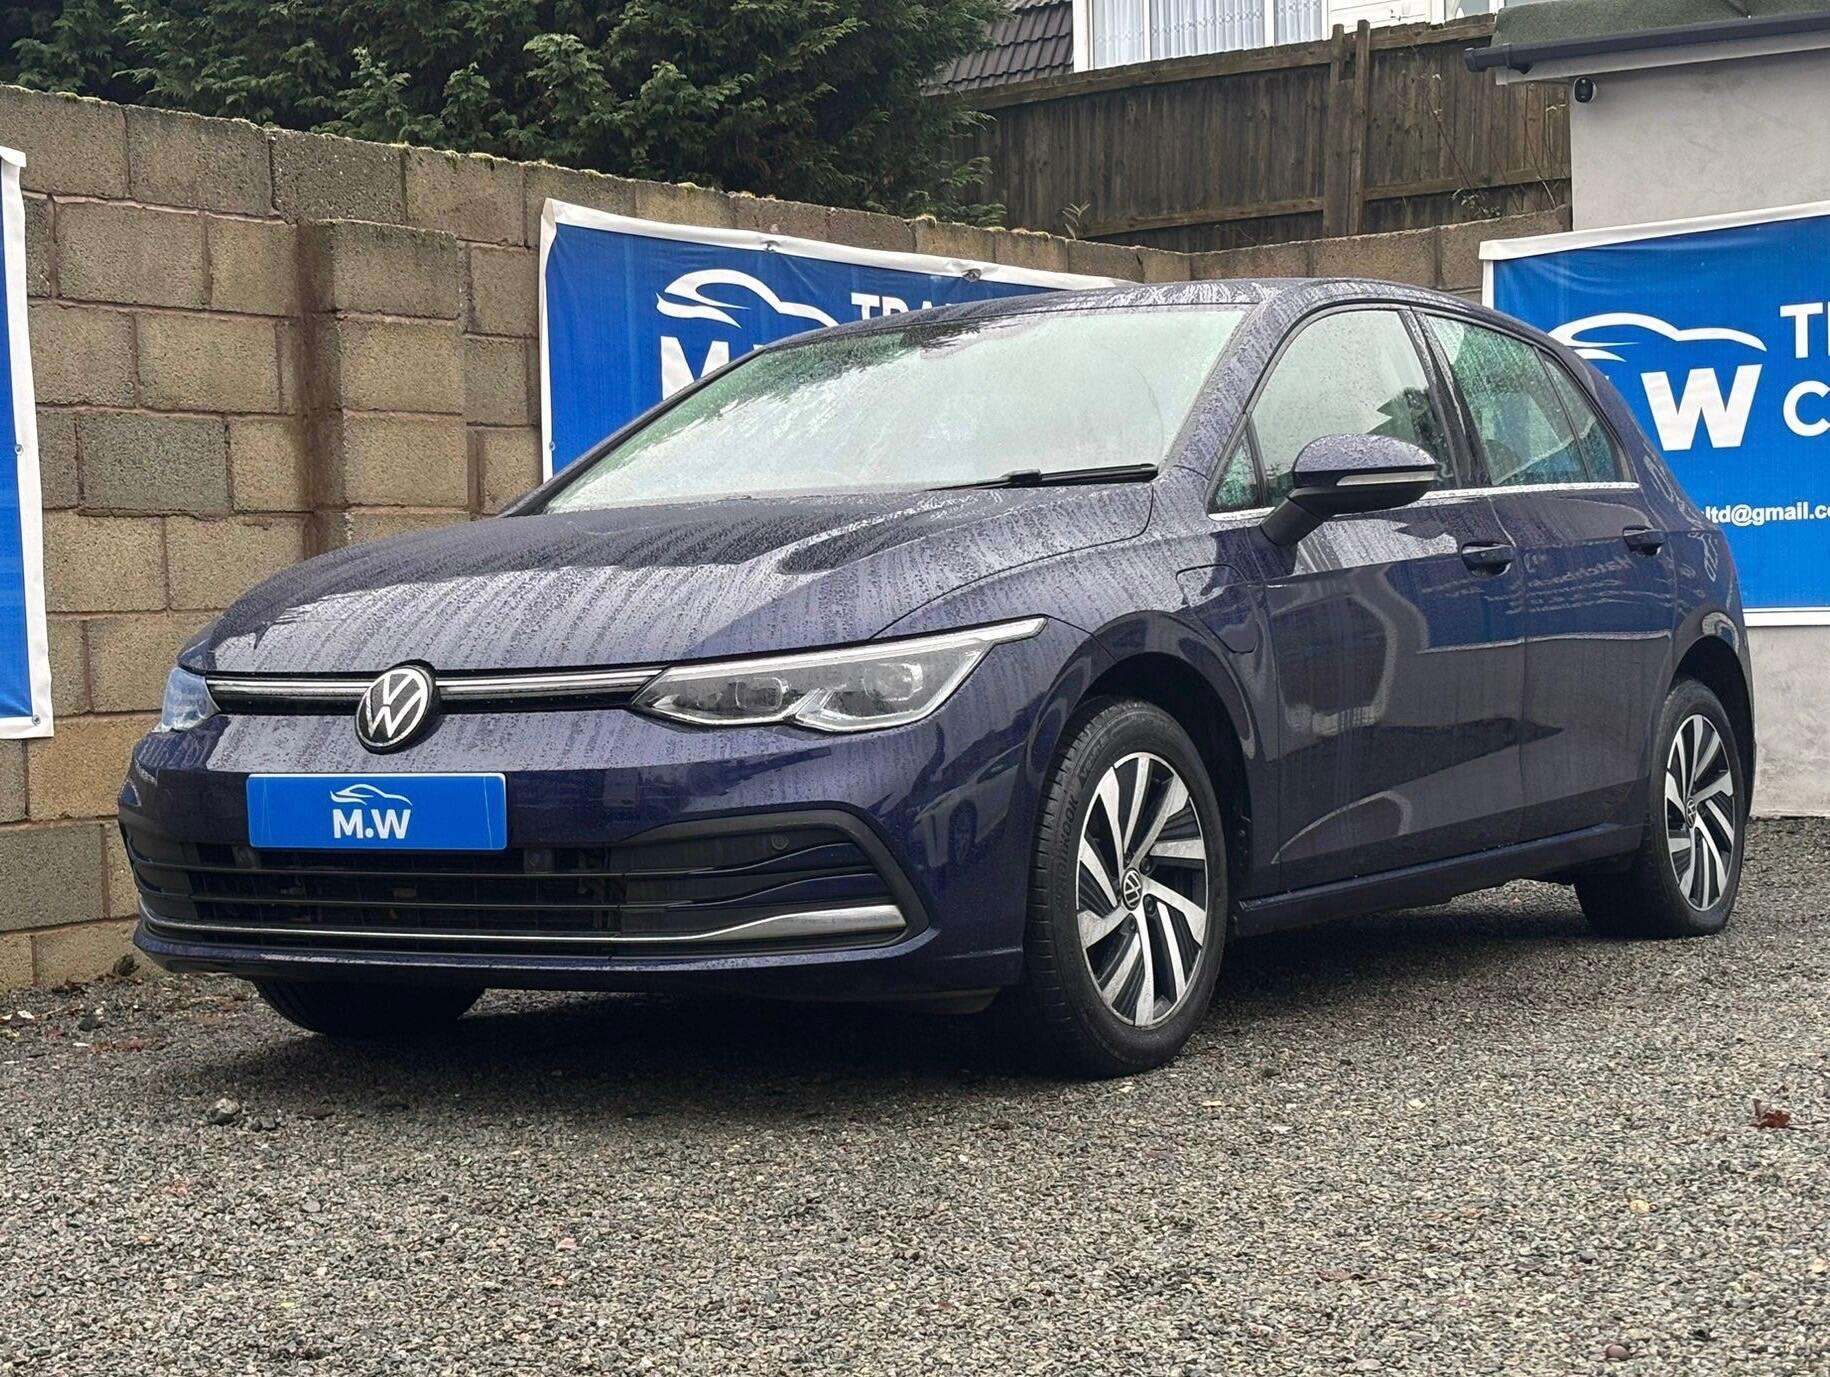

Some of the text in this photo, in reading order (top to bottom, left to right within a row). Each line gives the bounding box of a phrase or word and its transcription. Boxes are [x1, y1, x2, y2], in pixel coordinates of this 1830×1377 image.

[1779, 301, 1830, 359] T
[1701, 501, 1830, 527] ltd@gmail.c
[332, 808, 412, 840] M.W
